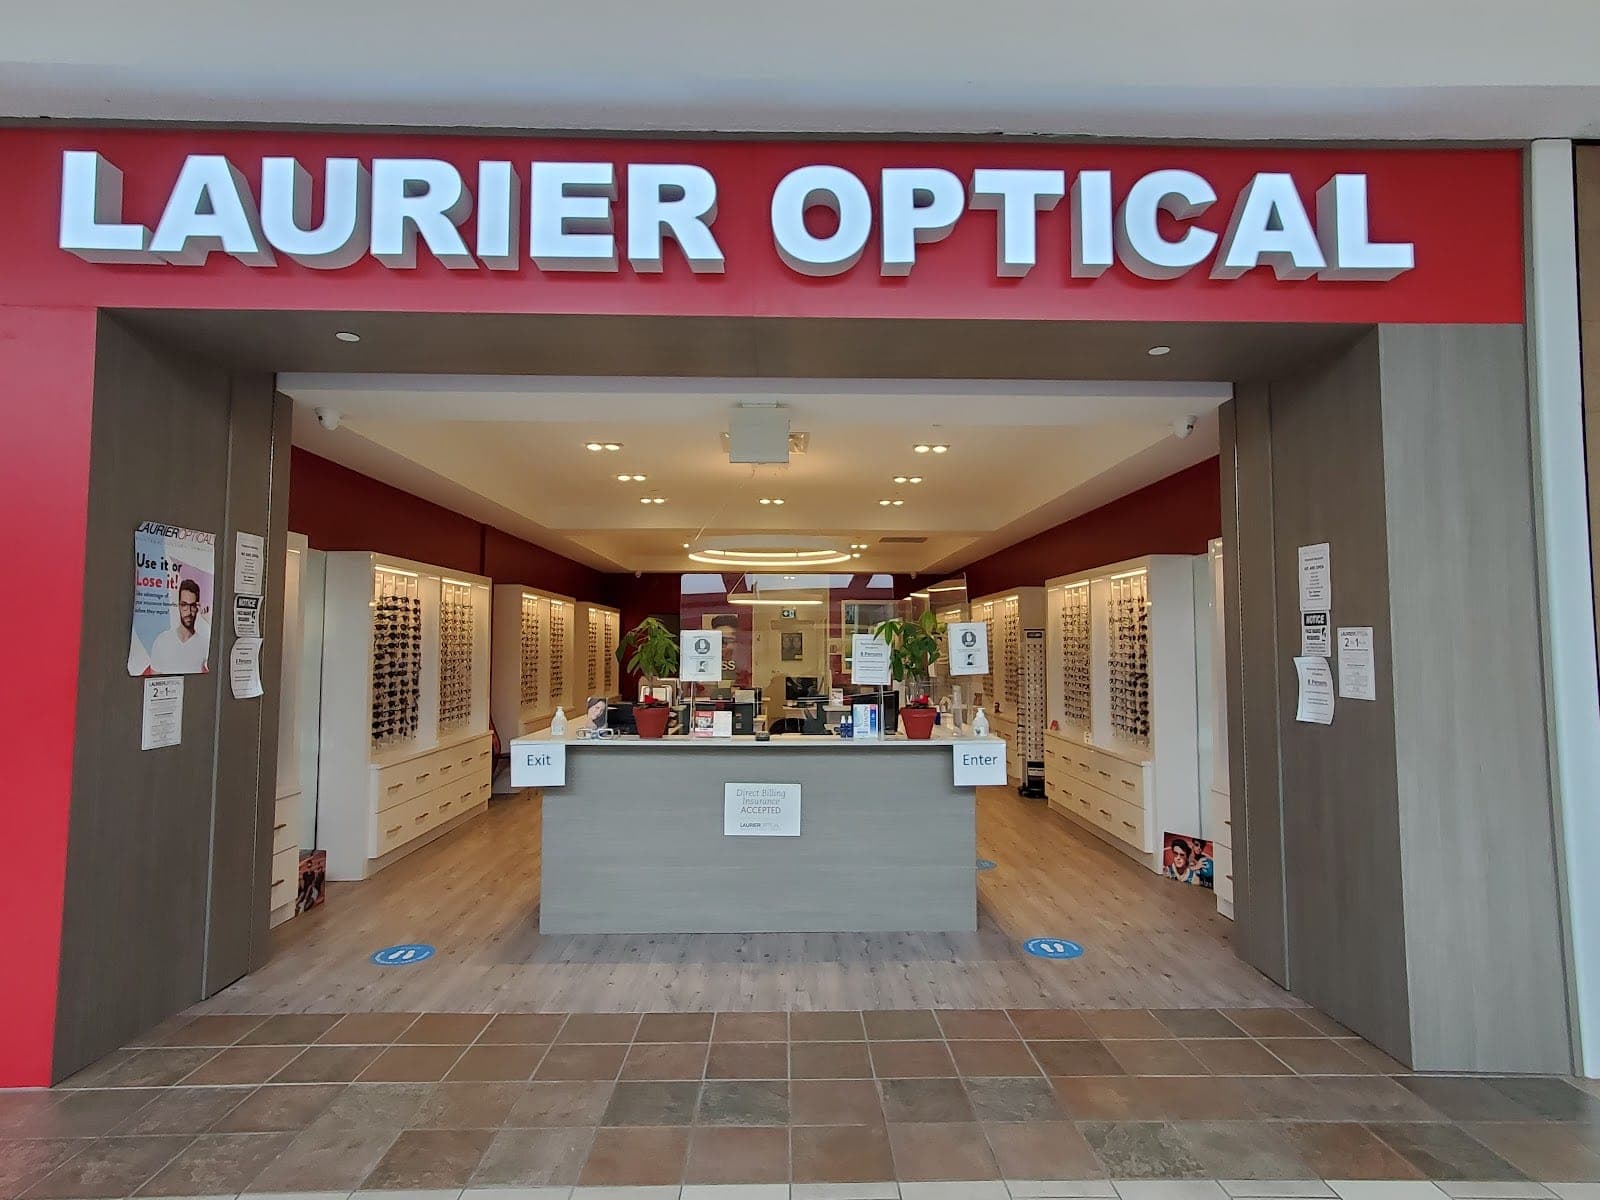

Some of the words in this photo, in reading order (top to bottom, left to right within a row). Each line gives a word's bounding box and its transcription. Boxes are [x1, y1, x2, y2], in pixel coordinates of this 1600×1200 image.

[59, 150, 726, 262] LAURIER
[770, 164, 1416, 271] OPTICAL
[136, 552, 157, 570] Use
[160, 556, 169, 571] it
[172, 563, 183, 573] or
[136, 569, 162, 588] Lose
[166, 573, 179, 590] it!
[1305, 614, 1325, 625] NOTICE
[527, 754, 552, 767] Exit
[962, 753, 998, 767] Enter
[736, 788, 759, 797] Direct
[762, 788, 786, 800] Billing
[742, 797, 780, 805] Insurance
[740, 806, 781, 814] ACCEPTED
